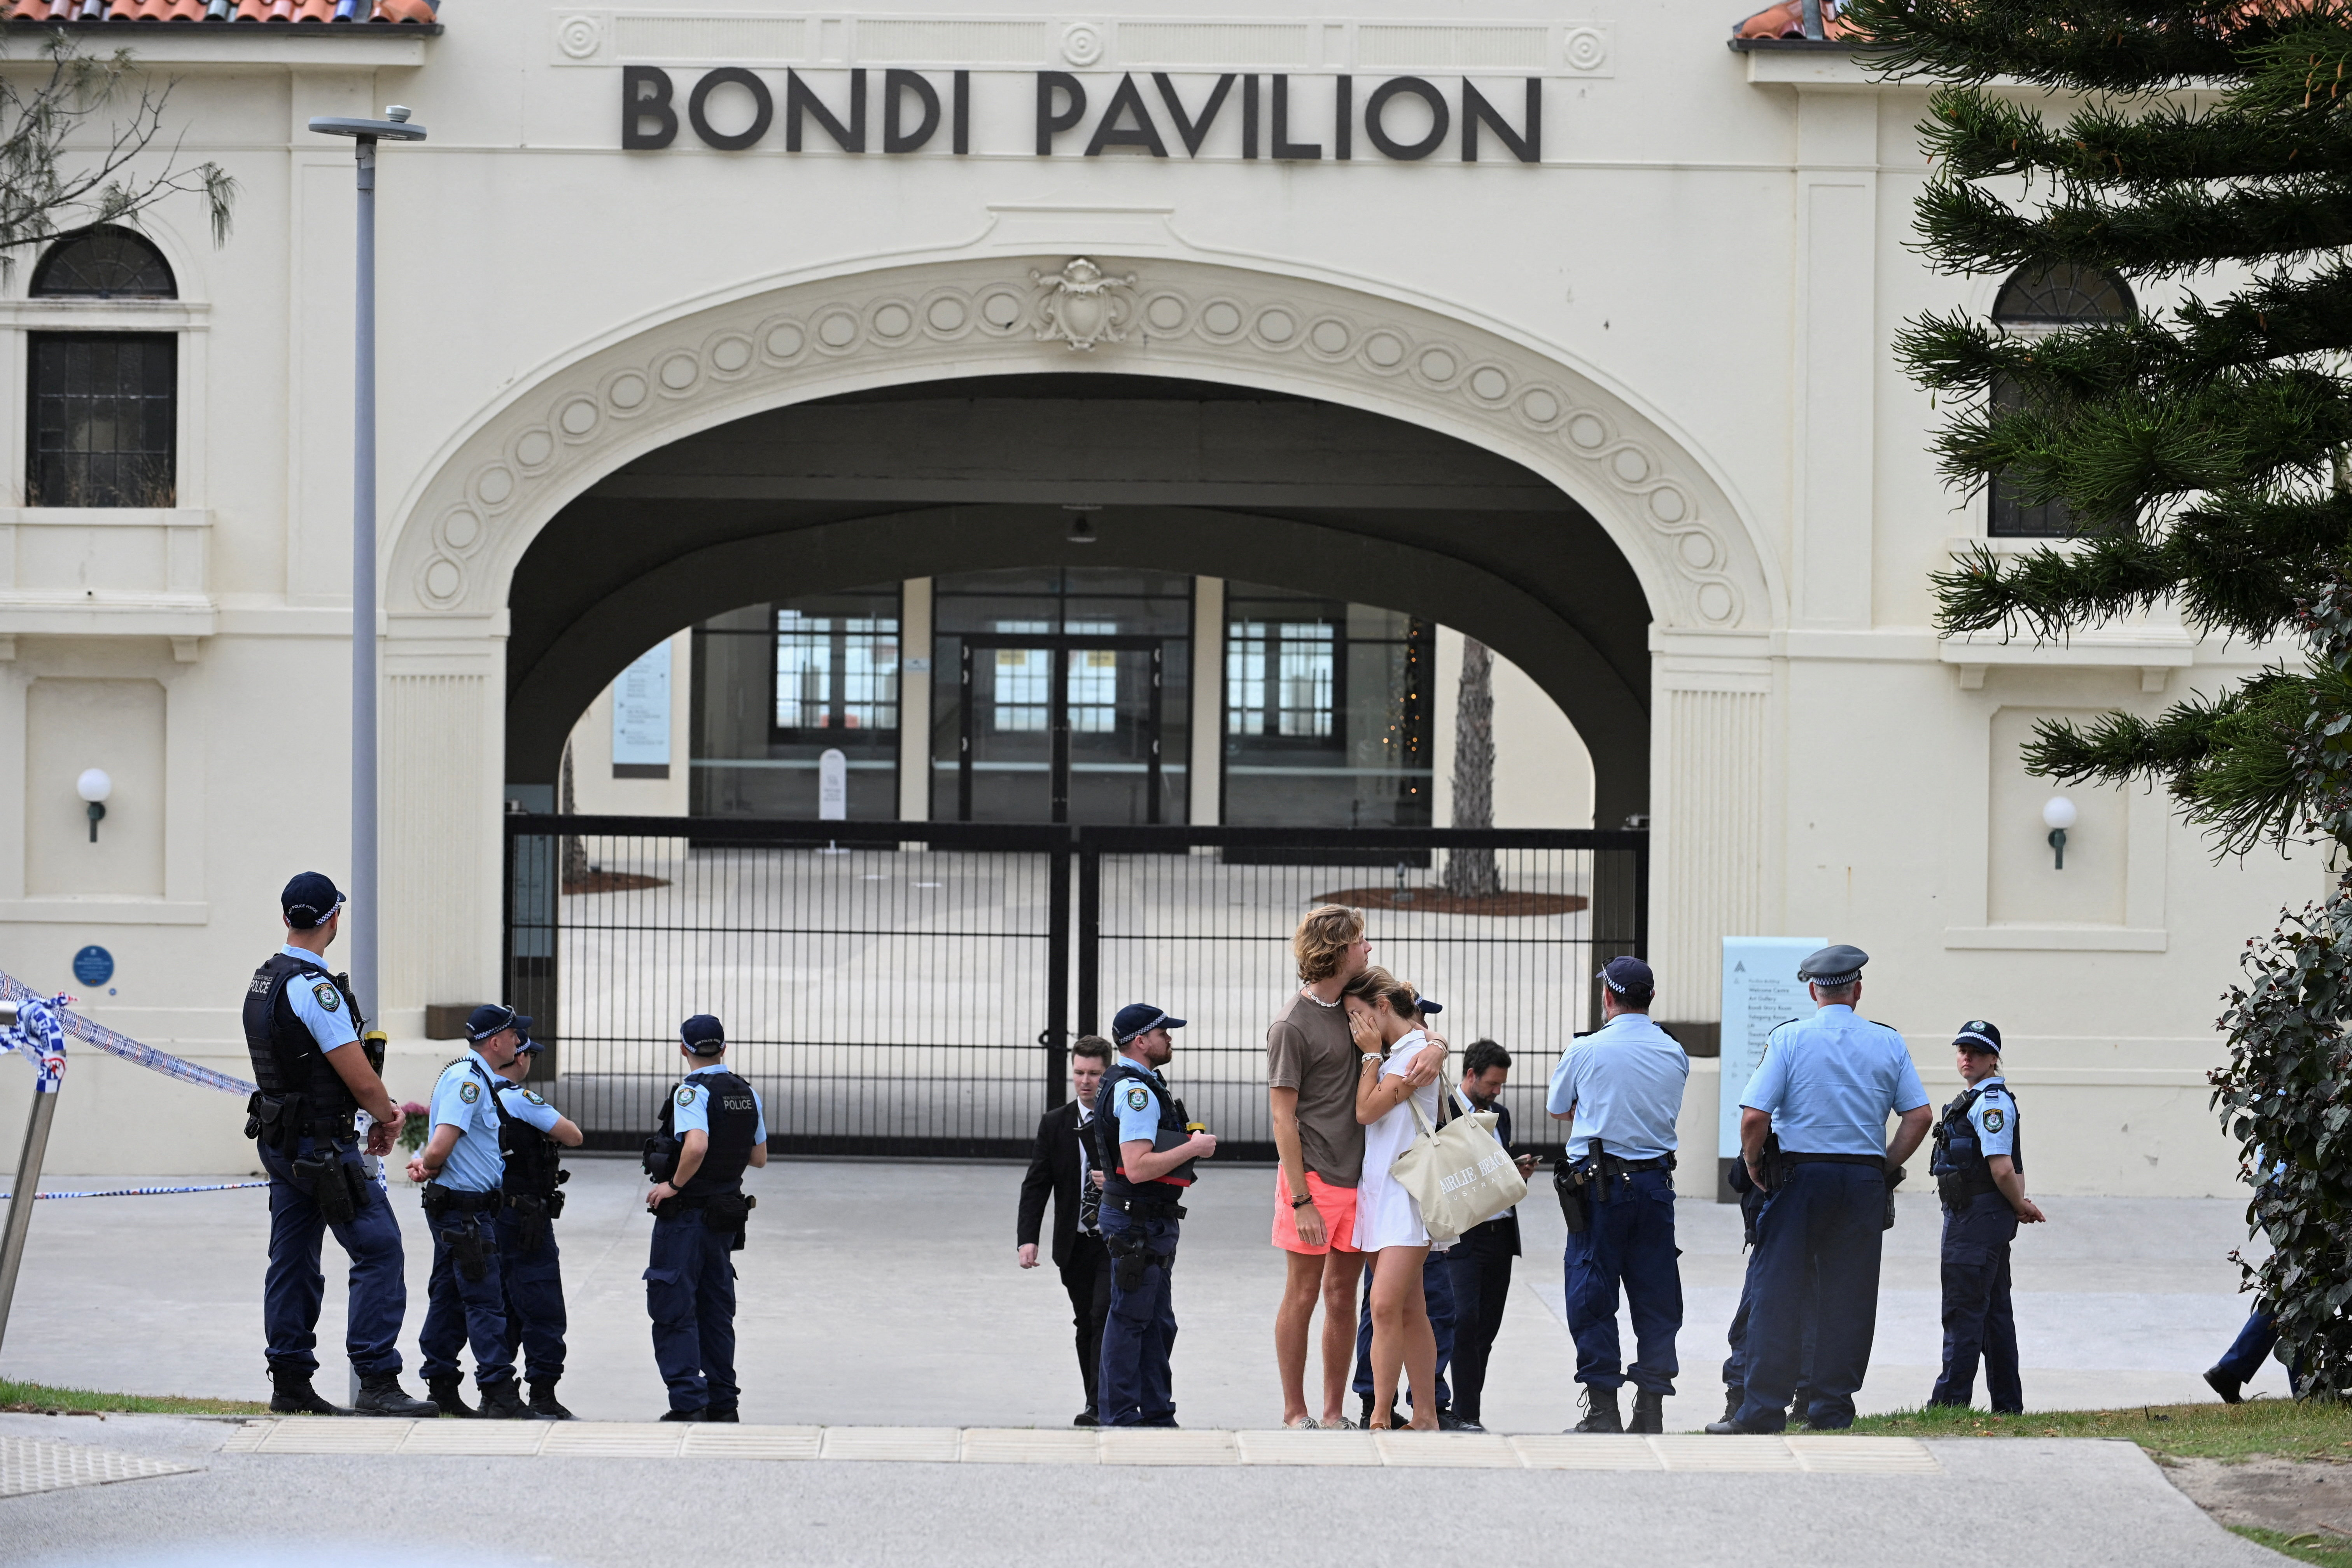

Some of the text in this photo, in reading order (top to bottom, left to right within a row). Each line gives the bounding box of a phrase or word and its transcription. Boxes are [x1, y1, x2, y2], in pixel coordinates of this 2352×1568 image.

[622, 65, 1542, 163] BONDI PAVILION
[306, 905, 318, 914] FORCE
[248, 979, 271, 994] POLICE
[724, 1100, 752, 1110] POLICE
[1439, 1149, 1509, 1195] AIRLIE BEACH
[1446, 1166, 1515, 1204] USTRALI
